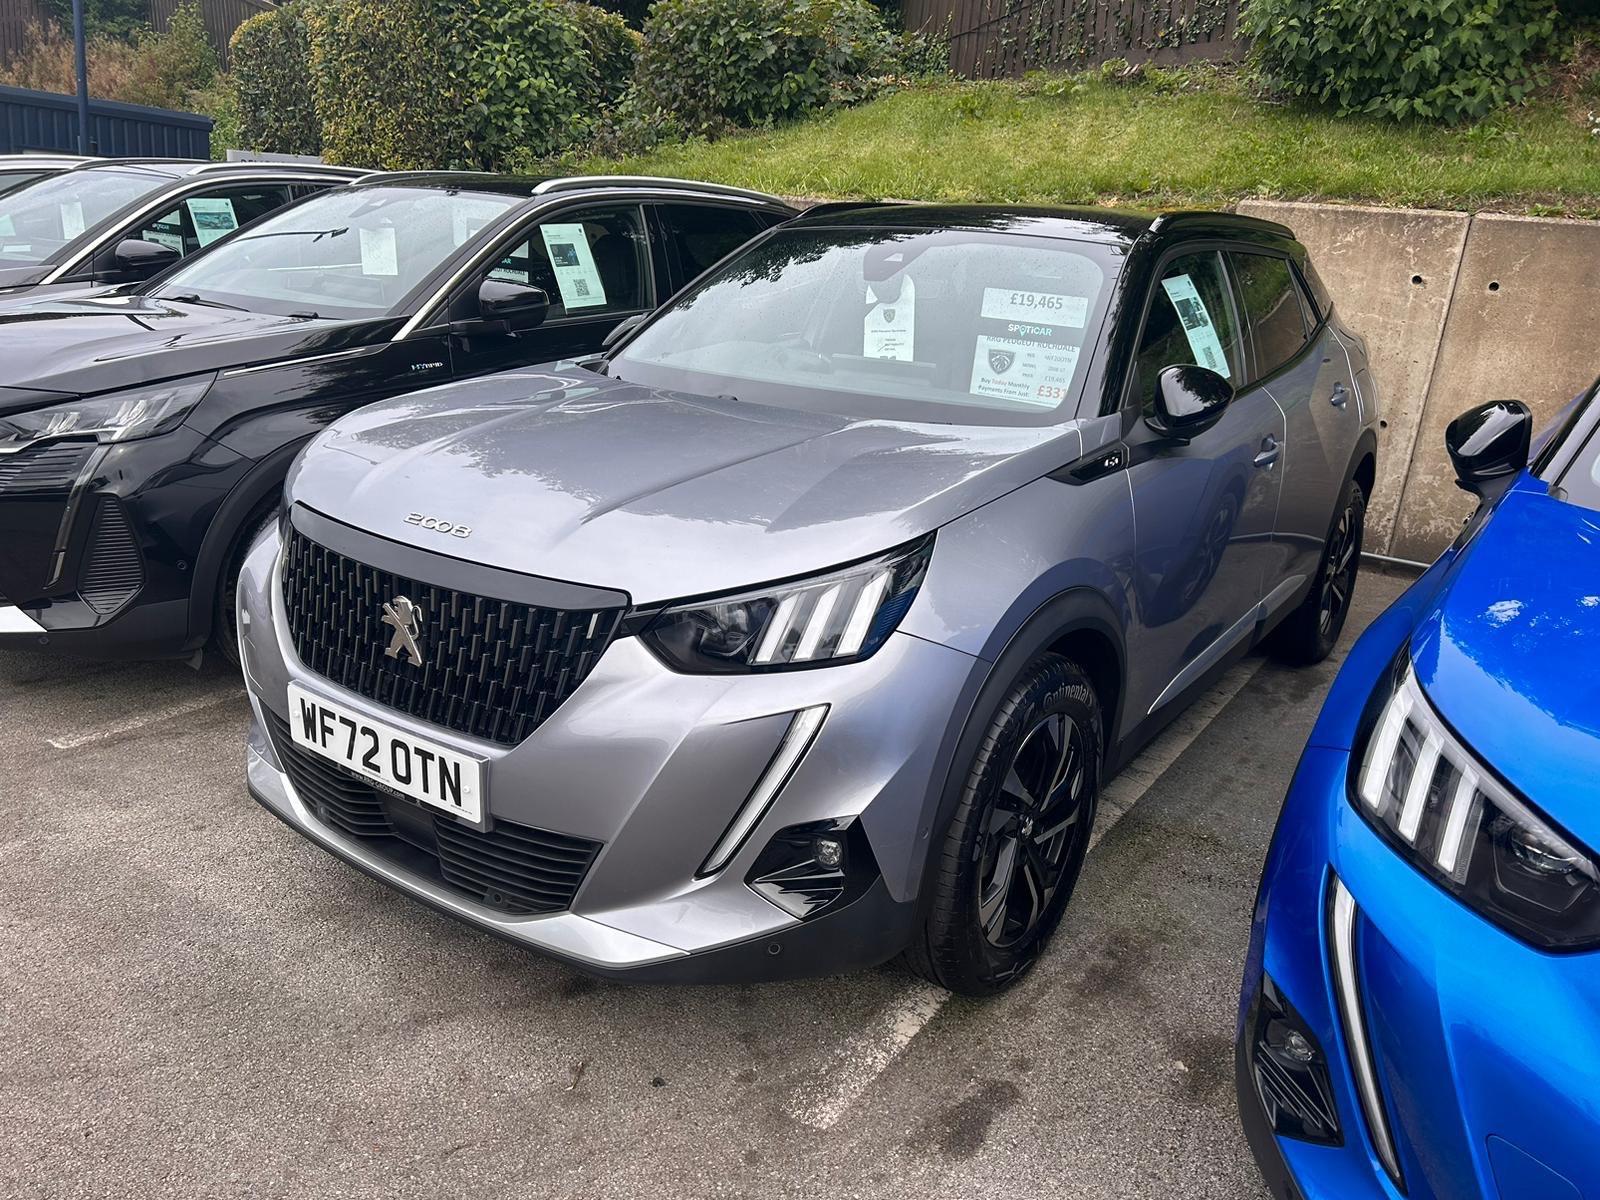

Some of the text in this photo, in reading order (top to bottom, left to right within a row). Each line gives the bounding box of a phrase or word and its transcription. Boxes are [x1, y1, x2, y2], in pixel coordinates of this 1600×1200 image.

[1009, 292, 1064, 310] £19,465
[978, 385, 1003, 394] Payments
[1007, 381, 1030, 390] Monthly
[403, 512, 472, 538] 2008
[300, 697, 462, 807] WF72 OTN
